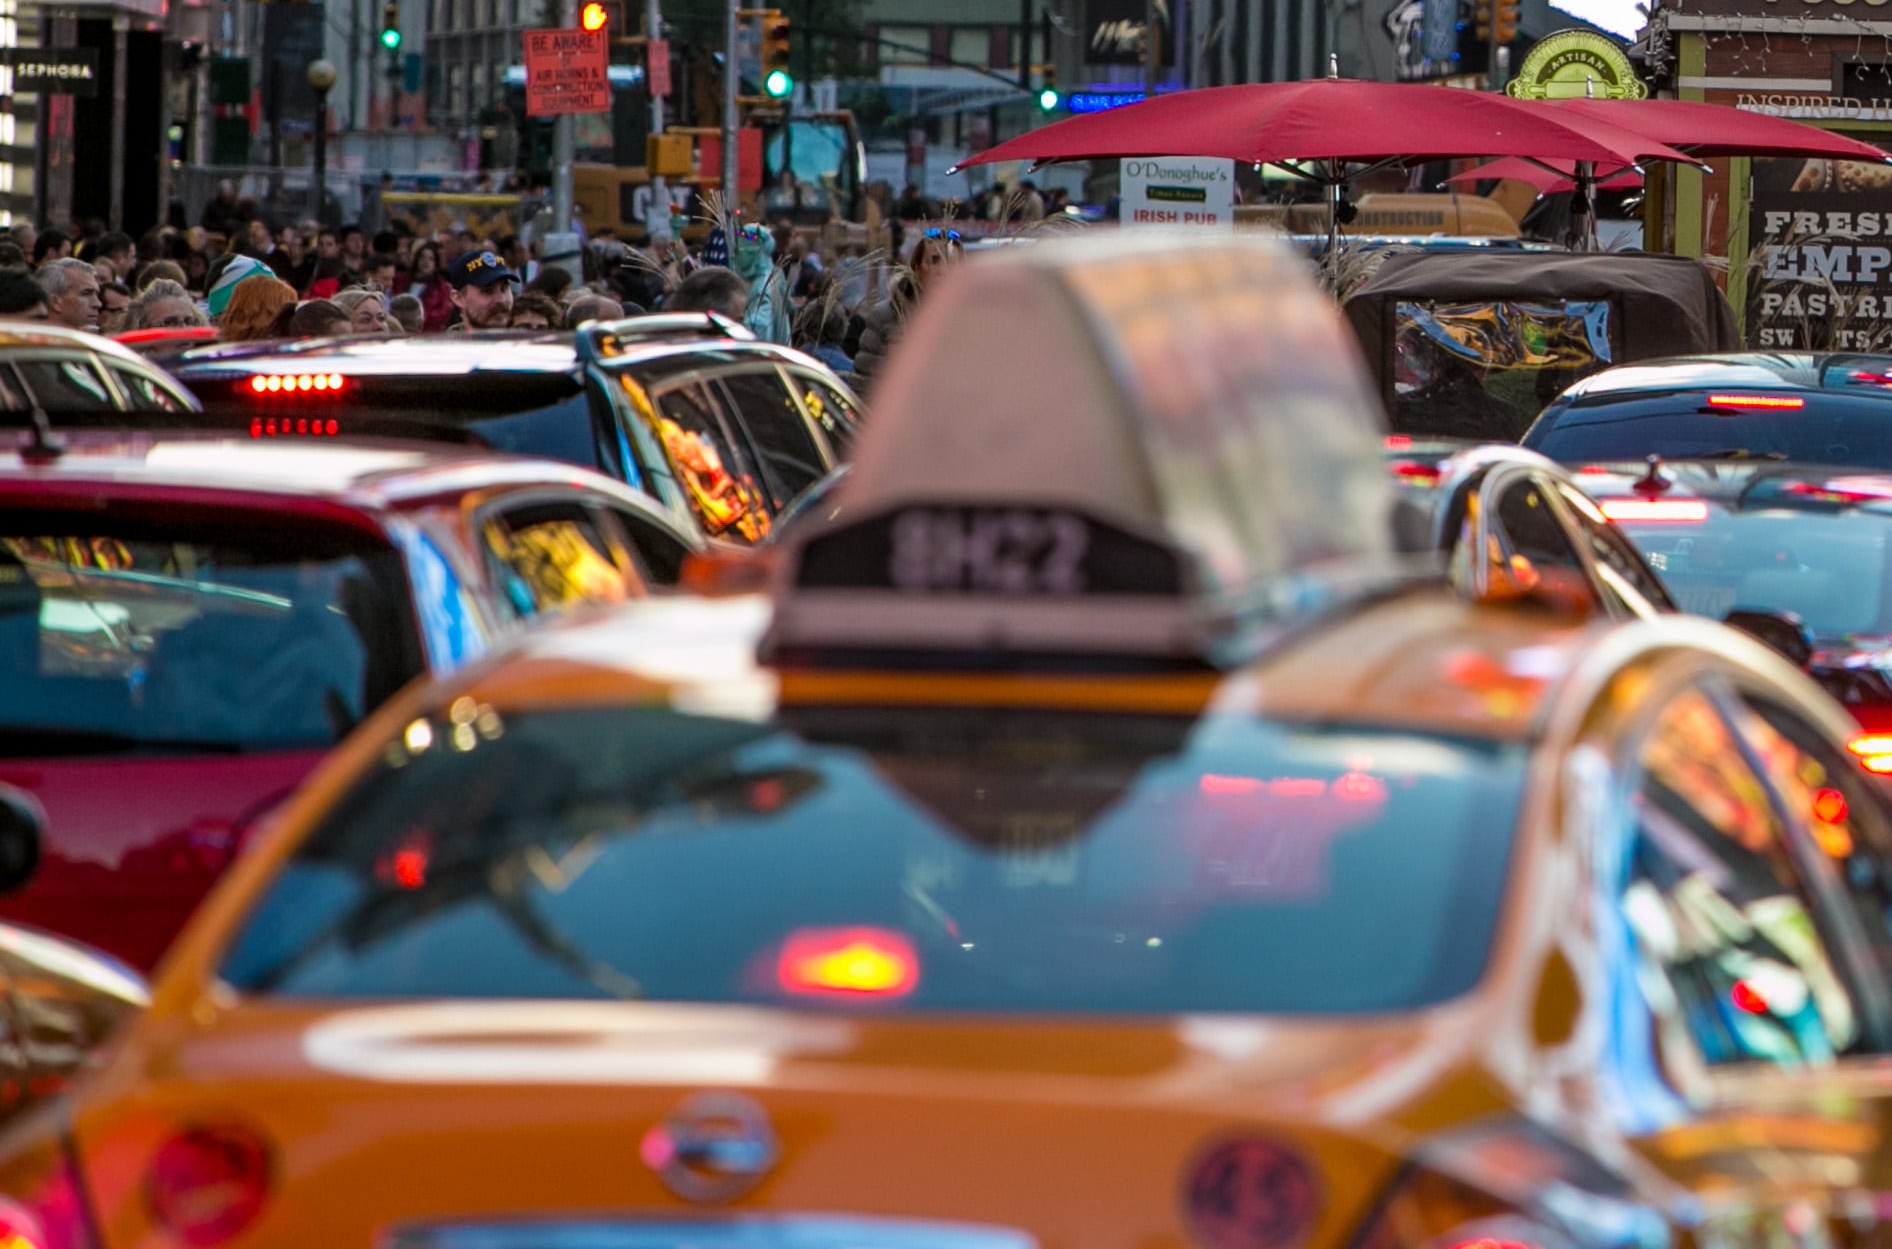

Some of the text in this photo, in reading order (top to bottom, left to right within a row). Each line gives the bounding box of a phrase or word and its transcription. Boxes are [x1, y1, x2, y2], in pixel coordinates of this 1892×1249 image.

[531, 36, 548, 50] BE
[17, 63, 93, 80] SEPHORA
[1550, 50, 1606, 73] ARTISAN
[1736, 94, 1864, 121] INSPIRED
[1126, 161, 1227, 183] O'Donoghue's
[1133, 209, 1217, 226] IRISH PUB
[1759, 327, 1872, 349] SWTS
